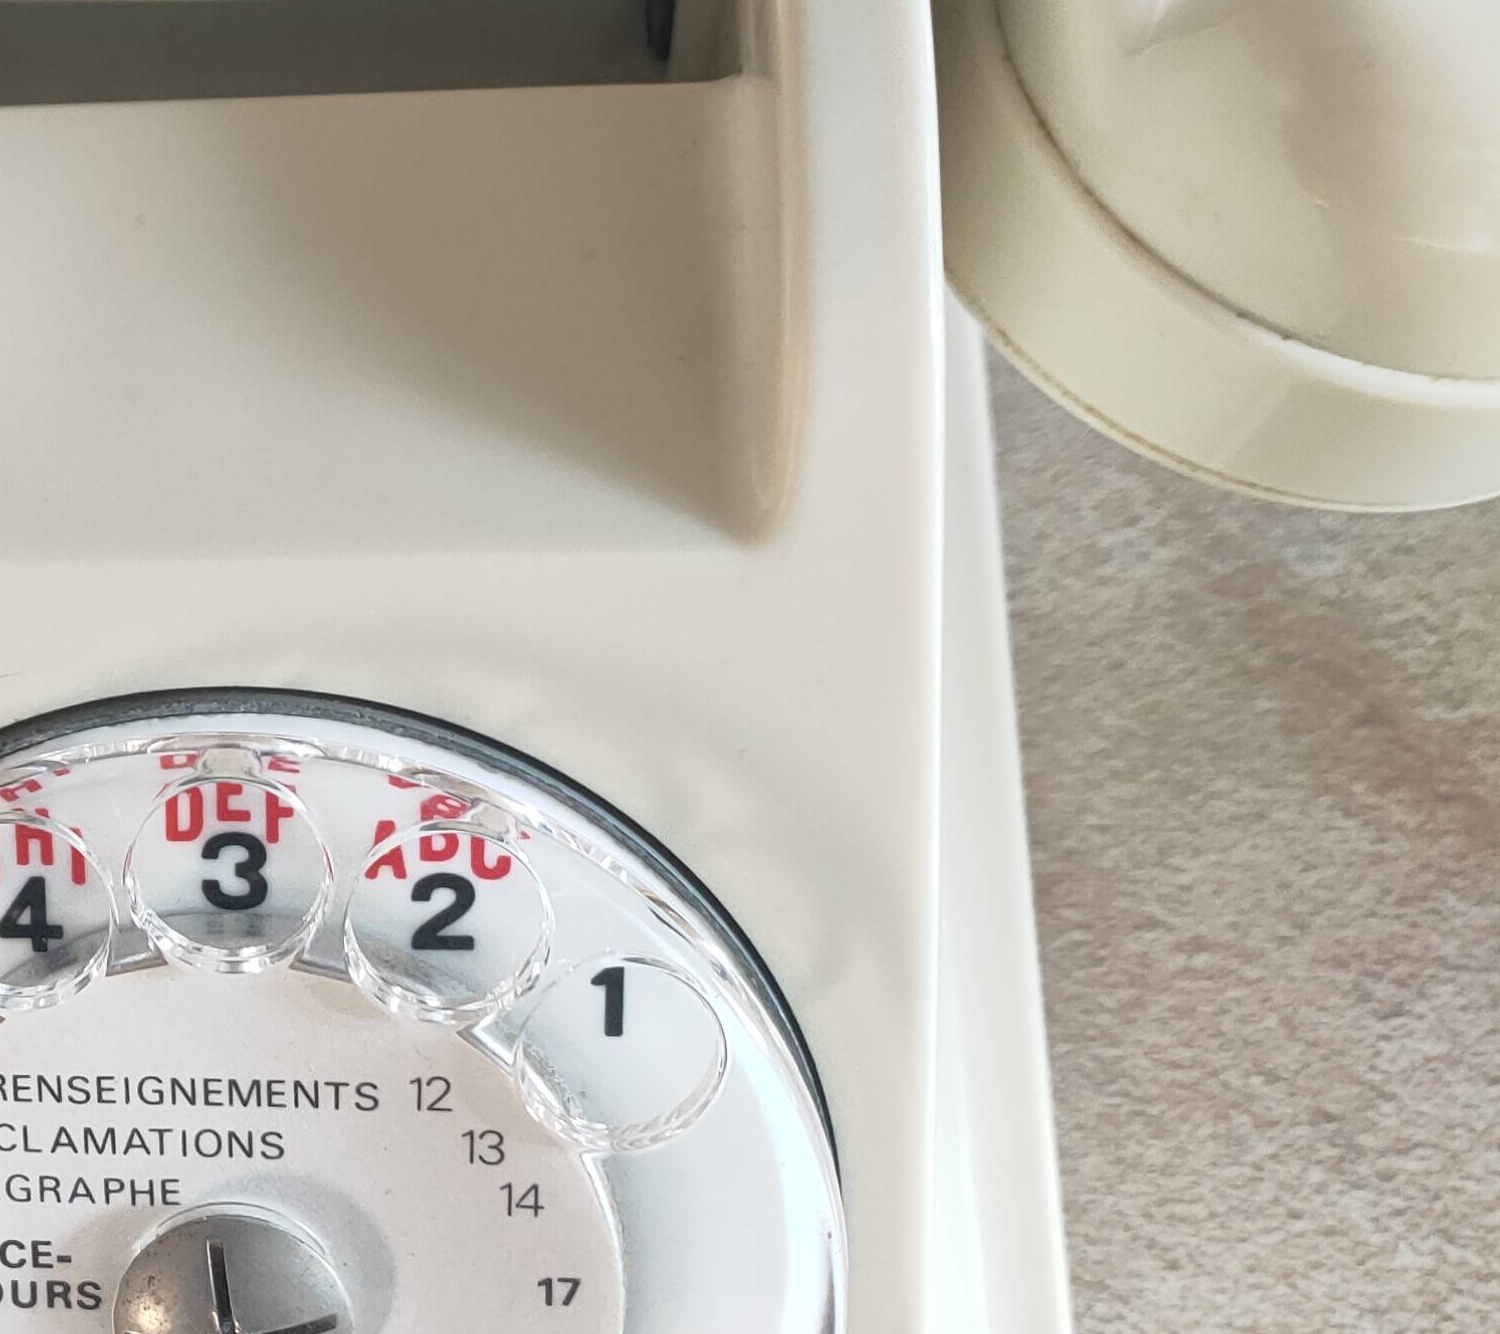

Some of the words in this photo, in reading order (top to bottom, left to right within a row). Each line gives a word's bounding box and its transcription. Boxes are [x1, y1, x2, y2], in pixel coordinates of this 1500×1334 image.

[201, 831, 268, 911] 3
[411, 872, 476, 951] 2
[590, 967, 625, 1037] 1
[409, 1076, 454, 1112] 12
[461, 1129, 506, 1166] 13
[500, 1182, 545, 1218] 14
[537, 1277, 582, 1307] 17
